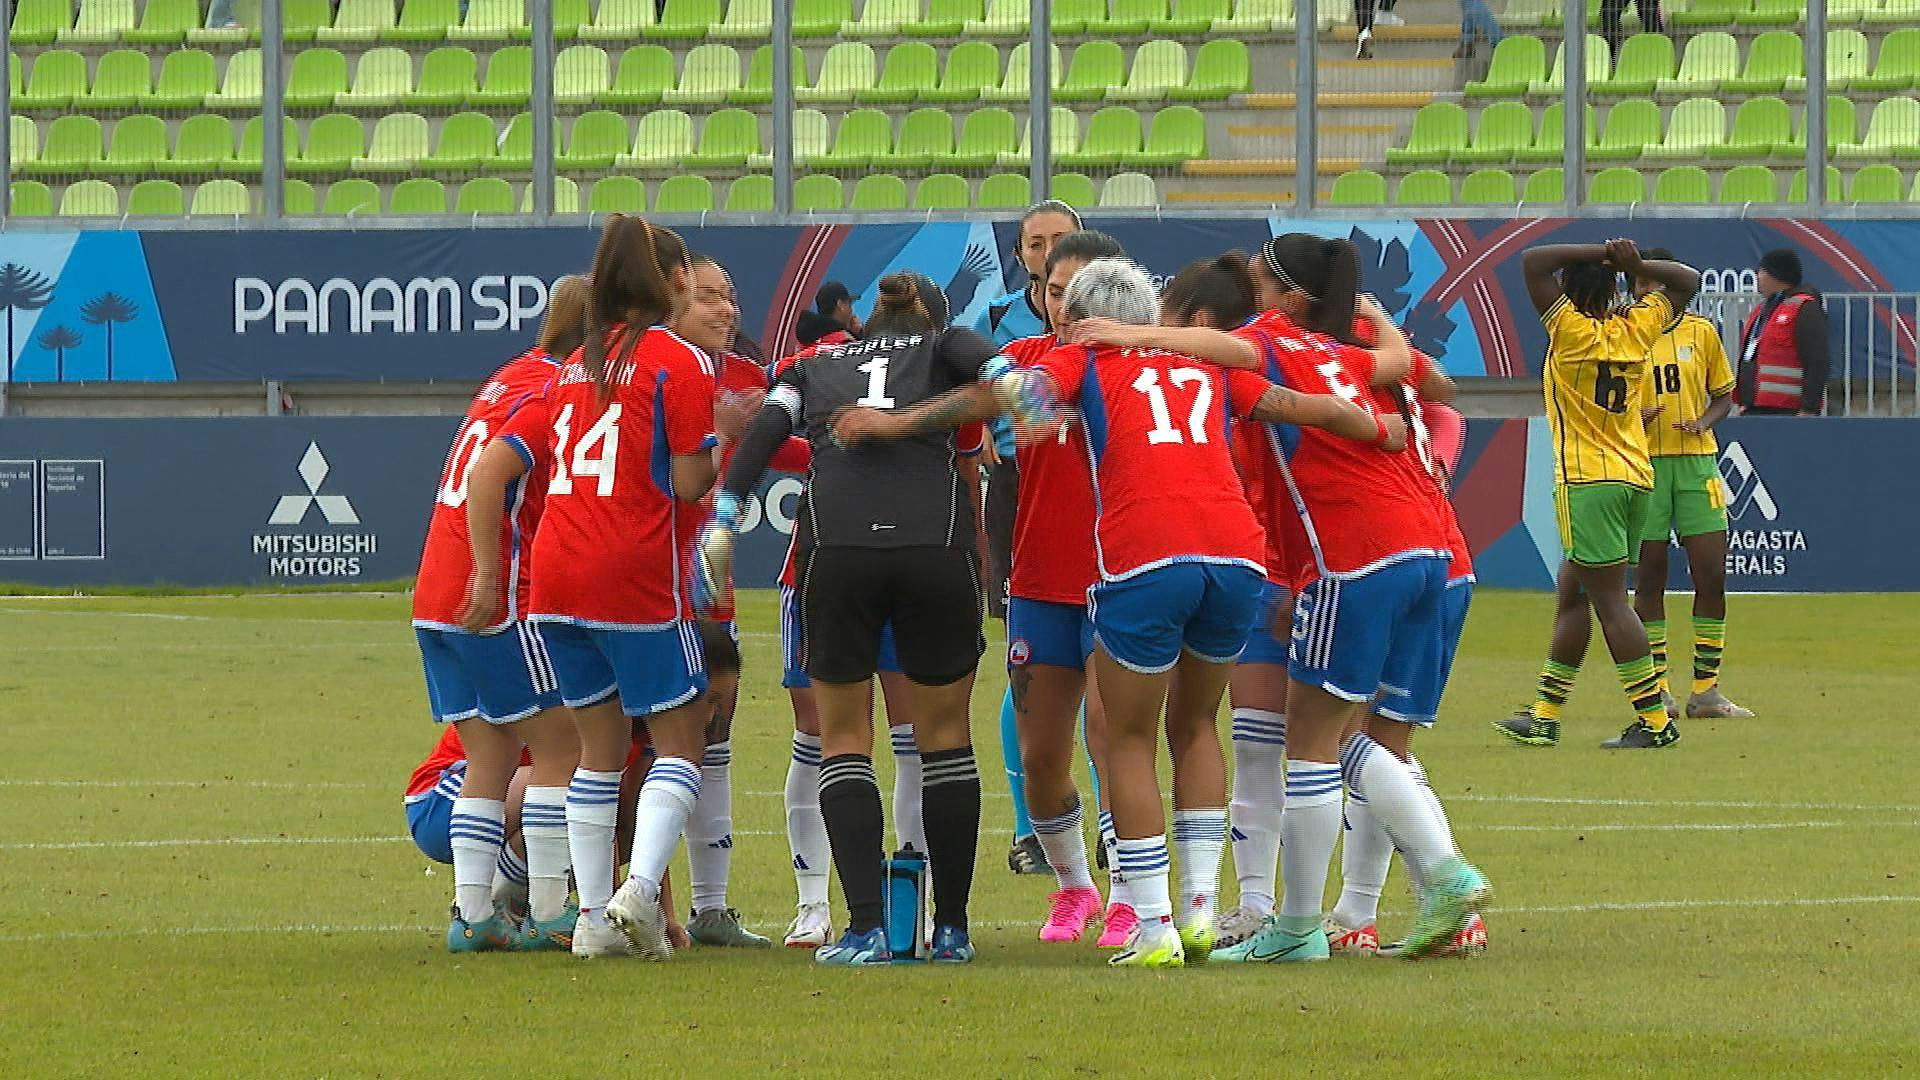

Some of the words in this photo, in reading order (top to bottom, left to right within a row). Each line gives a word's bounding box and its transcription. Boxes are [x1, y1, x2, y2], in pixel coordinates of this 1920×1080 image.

[234, 277, 462, 333] PANAM
[856, 356, 896, 409] 1
[1595, 363, 1628, 415] 6
[1652, 363, 1682, 395] 18
[1131, 367, 1214, 445] 17
[547, 402, 623, 497] 14
[252, 535, 377, 553] MITSUBISHI
[269, 557, 362, 577] MOTORS
